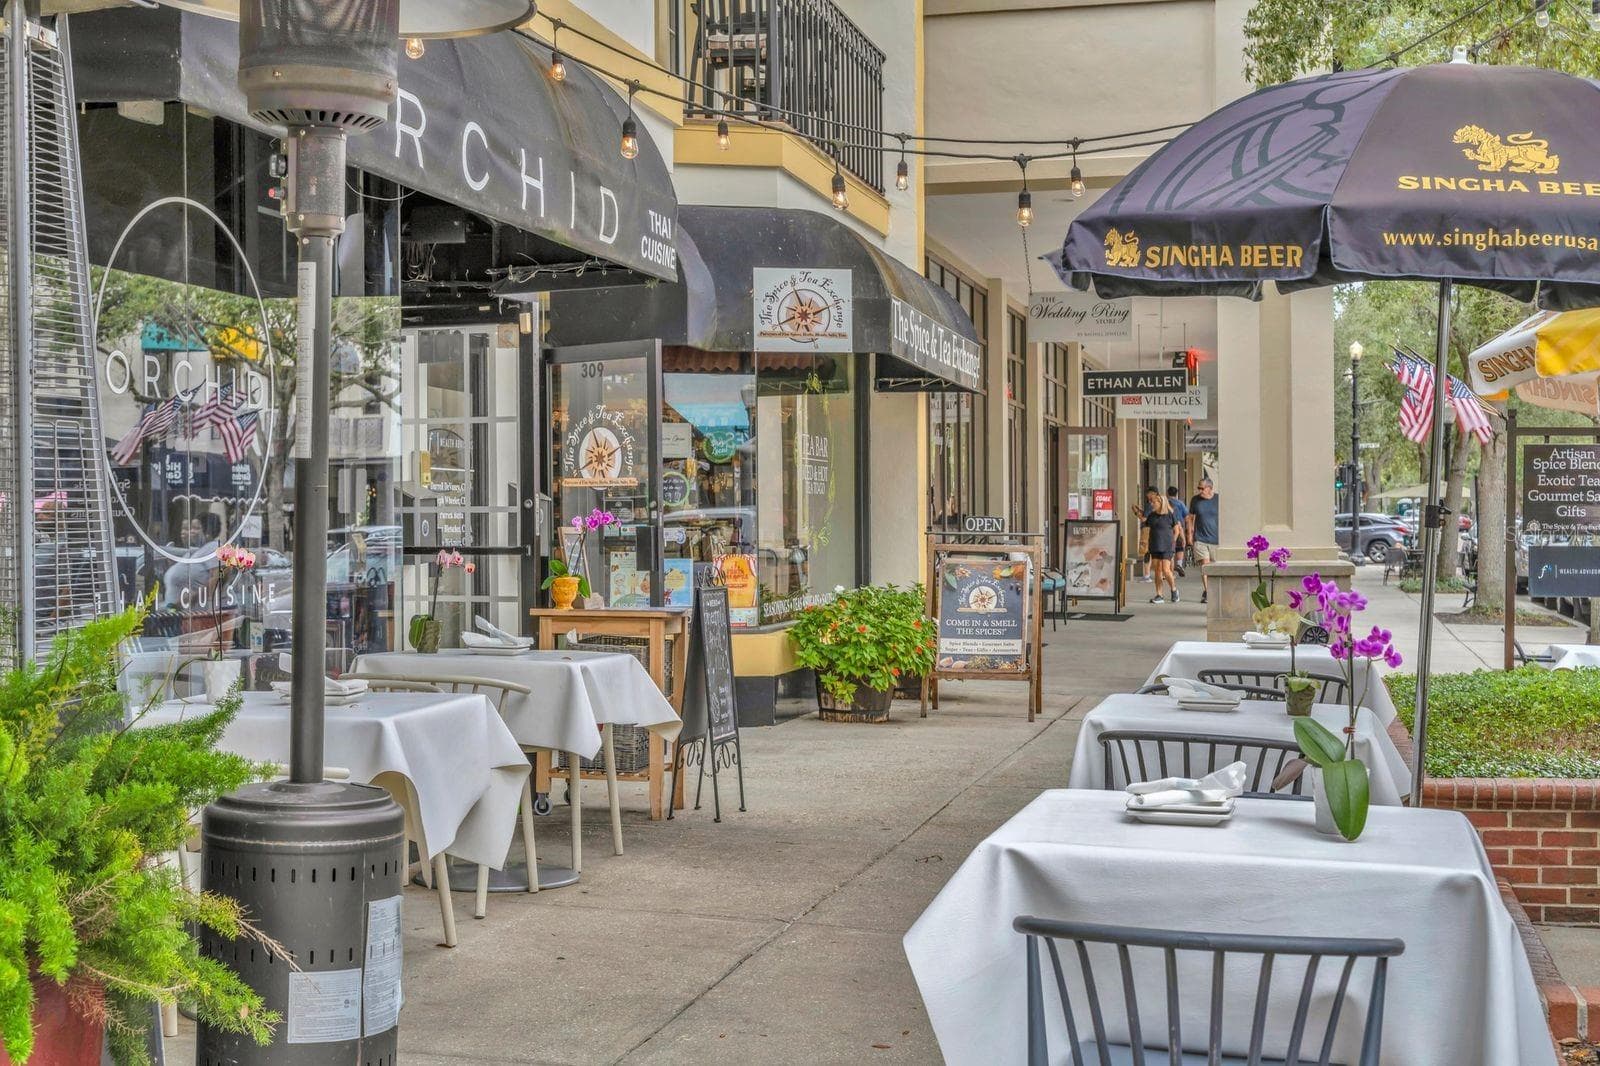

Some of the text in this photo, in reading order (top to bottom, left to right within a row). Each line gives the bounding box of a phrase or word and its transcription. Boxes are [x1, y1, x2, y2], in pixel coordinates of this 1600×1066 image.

[395, 87, 619, 244] RCHID
[1398, 176, 1529, 192] SINGHA
[648, 209, 672, 240] THAI
[641, 239, 676, 269] CUISINE
[1145, 245, 1304, 268] SINGHA BEER
[799, 271, 819, 285] Tea
[763, 281, 789, 304] Spice
[819, 277, 846, 329] Exchange
[759, 304, 773, 326] The
[1030, 301, 1130, 324] Wedding Ring
[892, 298, 980, 388] The Spice & Tea Exchange
[106, 350, 265, 409] ORCHID
[581, 362, 604, 378] 309
[1087, 376, 1182, 389] ETHAN ALLEN
[1145, 396, 1201, 406] VILLAGES
[567, 417, 588, 446] Spice
[596, 404, 612, 419] Tea
[815, 436, 828, 457] BAR
[1549, 448, 1596, 460] Artisan
[1533, 458, 1567, 472] Spice
[1537, 474, 1575, 487] Exotic
[1528, 490, 1584, 502] Gourmet
[1556, 506, 1587, 517] Gifts
[966, 517, 1003, 532] OPEN
[180, 583, 276, 608] CUISINE
[945, 618, 1018, 628] COME IN & SMELL
